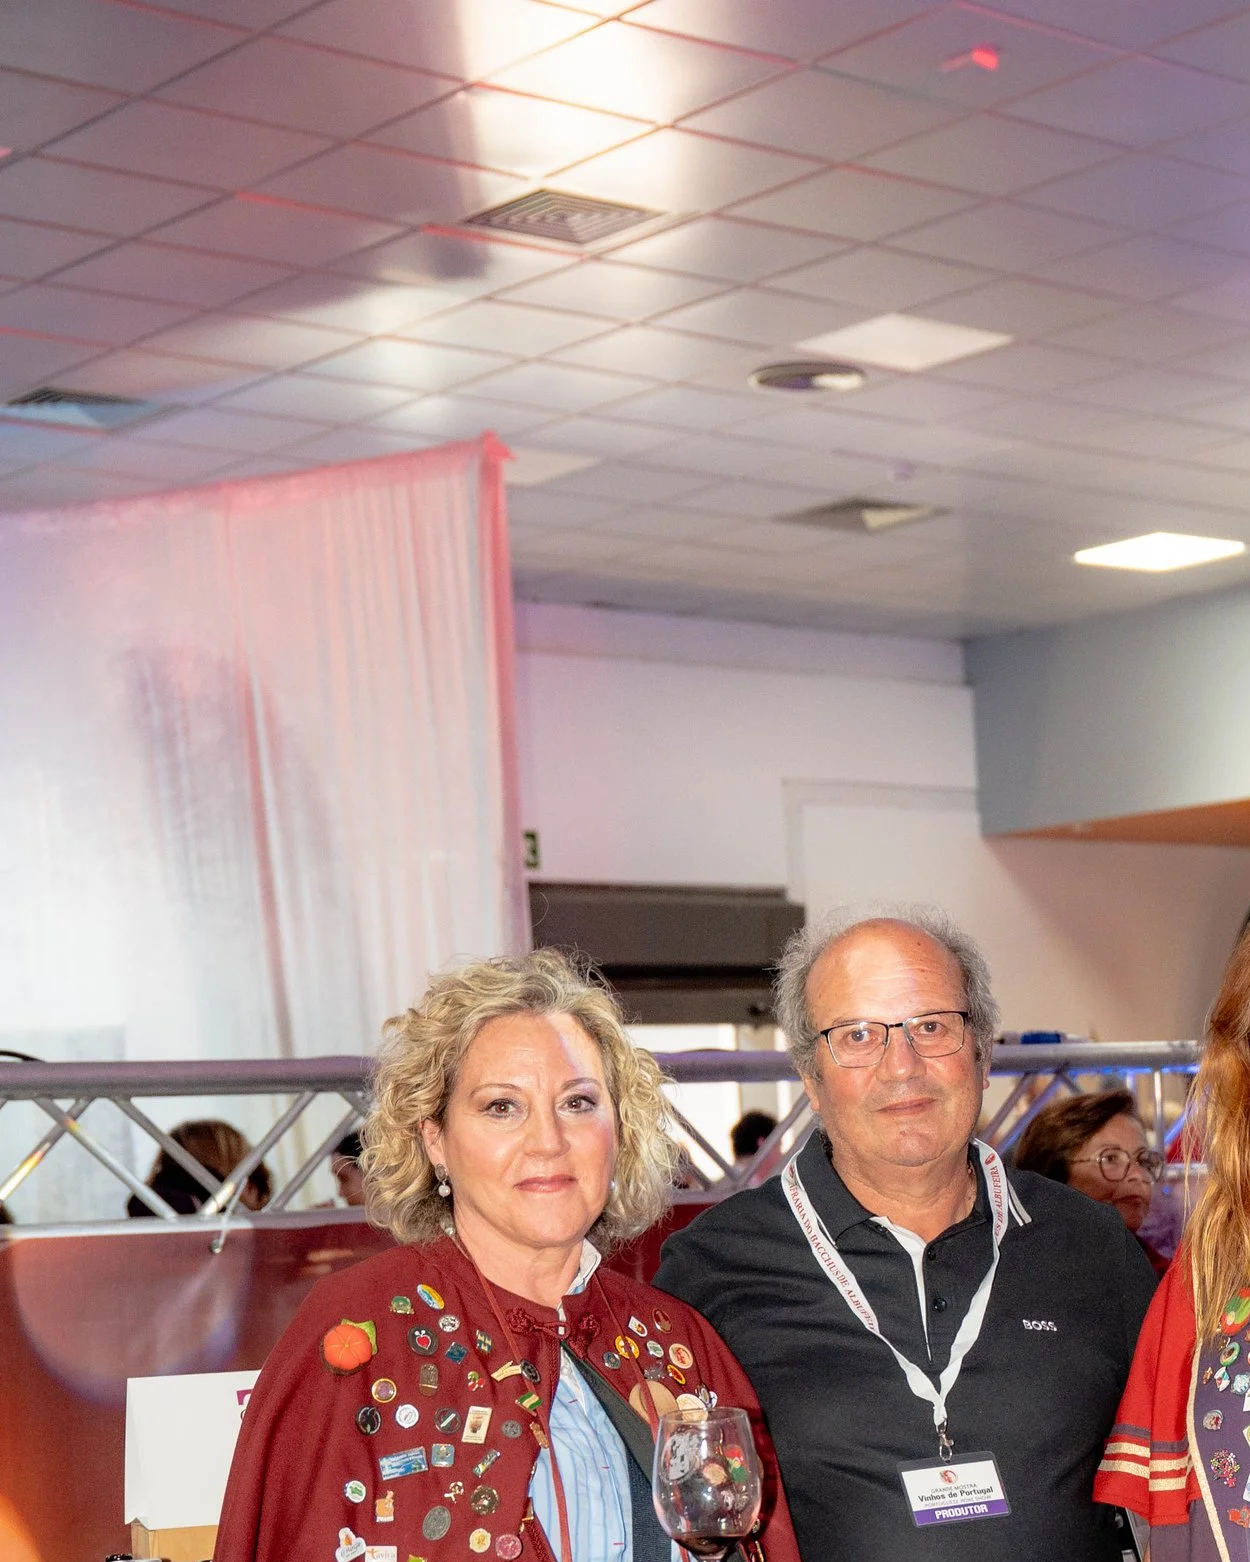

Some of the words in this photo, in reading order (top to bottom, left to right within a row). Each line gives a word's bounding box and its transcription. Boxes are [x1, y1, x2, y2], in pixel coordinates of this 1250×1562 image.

[990, 1165, 1003, 1210] ALBUFEIRA
[810, 1234, 841, 1277] BACCHUS
[837, 1274, 849, 1287] DE
[1022, 1319, 1058, 1331] BOSS
[918, 1493, 946, 1503] Vinhos
[960, 1486, 994, 1497] Portugal
[934, 1503, 989, 1520] PRODUTOR
